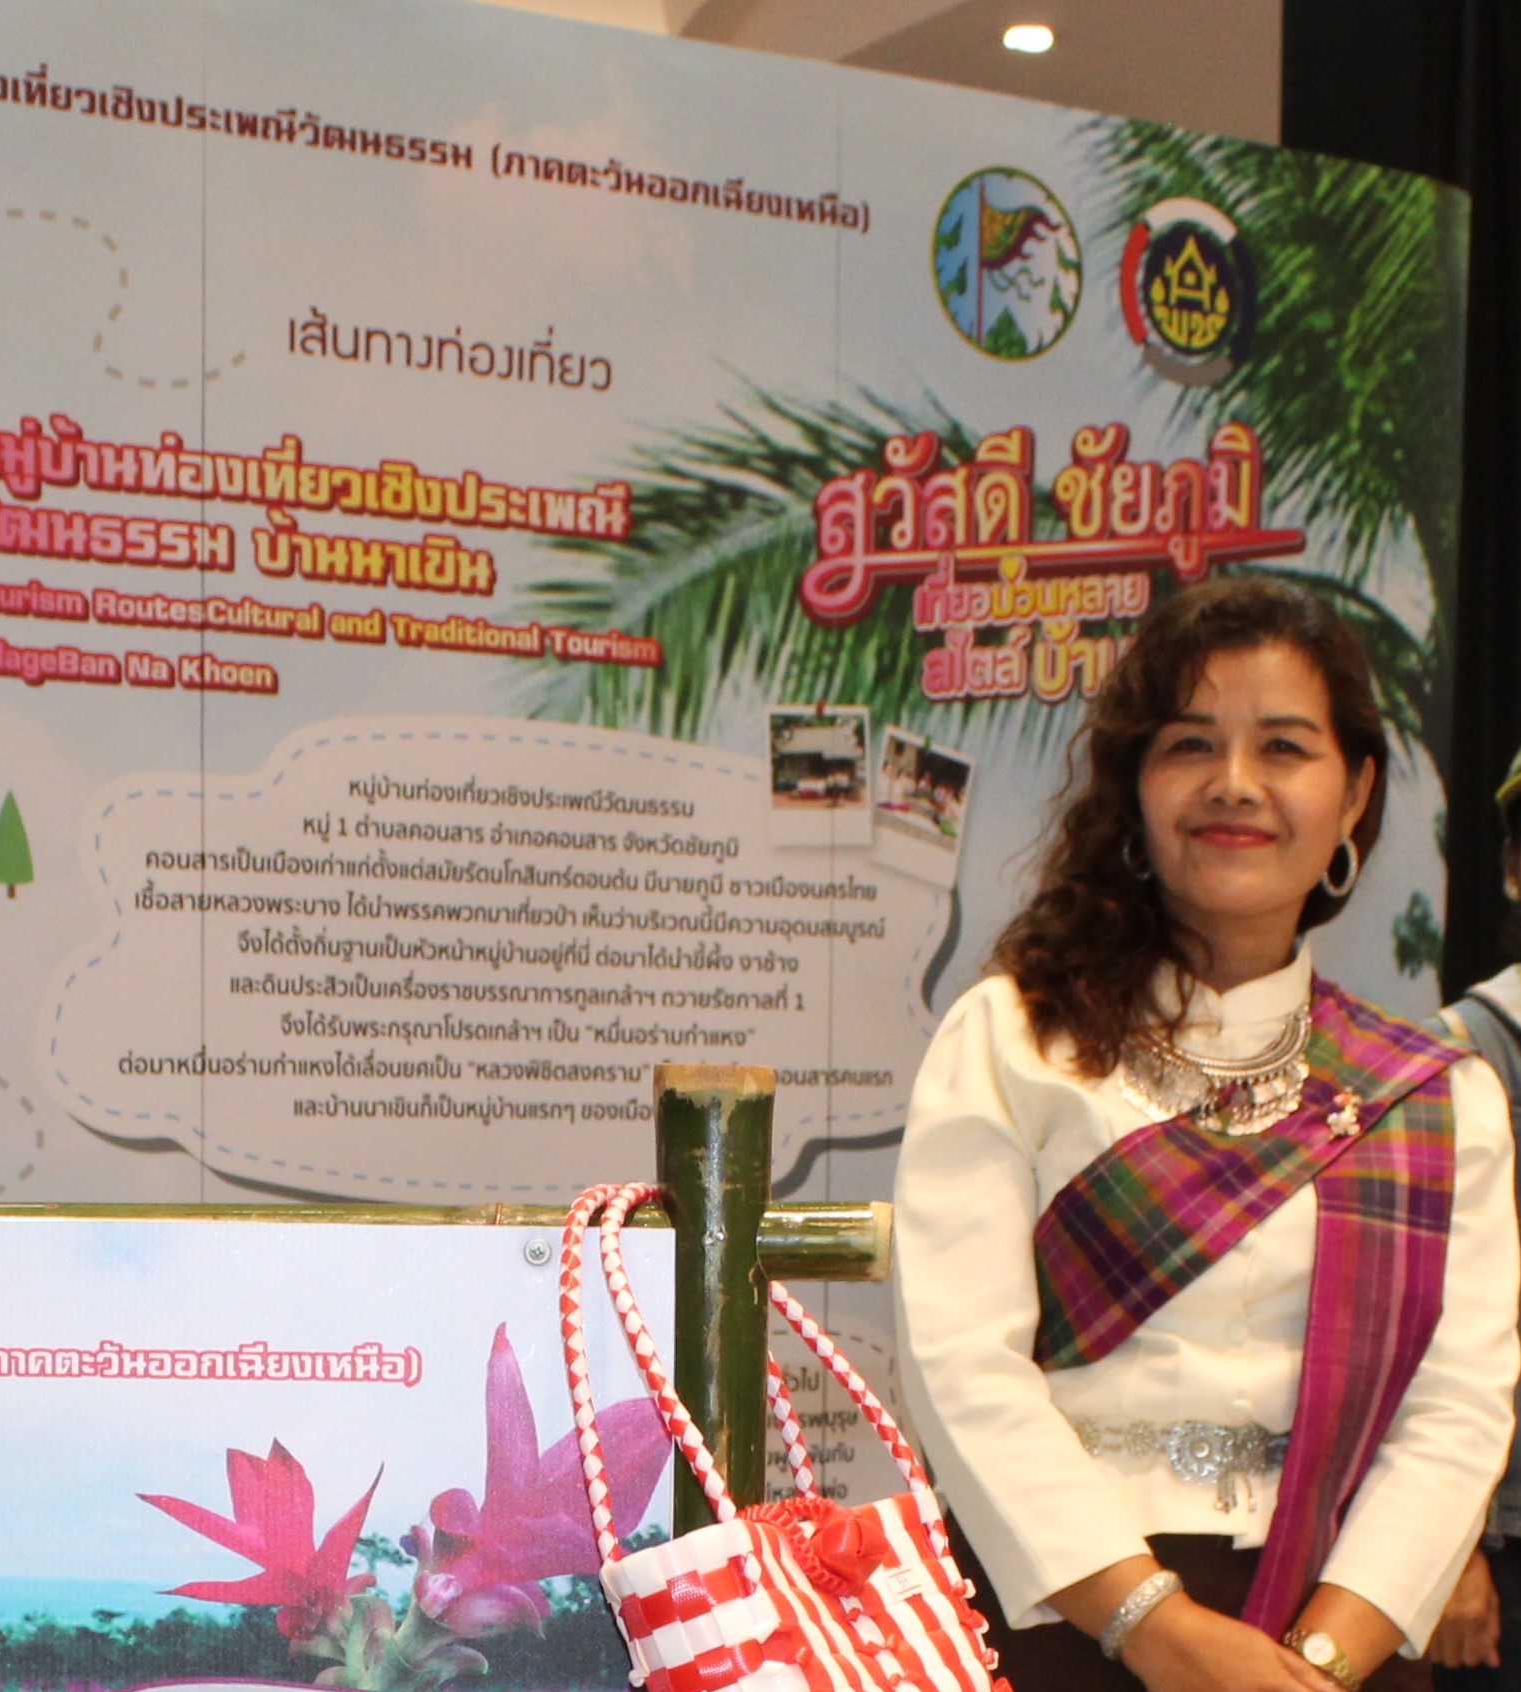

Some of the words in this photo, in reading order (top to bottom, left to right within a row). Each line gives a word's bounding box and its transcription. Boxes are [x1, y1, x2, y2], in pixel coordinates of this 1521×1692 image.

[490, 142, 871, 234] (ภาคตะวันออกเฉียงเหนือ)
[288, 306, 613, 392] เส้นทางท่องเที่ยว
[799, 425, 1037, 627] สวัสดี
[1054, 421, 1266, 583] ชัยภูมิ
[254, 511, 496, 595] บ้านนาเขิน
[328, 610, 381, 642] and
[390, 614, 542, 654] Traditional
[546, 626, 661, 666] Tourism
[124, 653, 172, 687] Na
[177, 656, 277, 692] Khoen
[921, 627, 1029, 706] สไตล์
[349, 773, 695, 818] หมู่บ้านท่องเที่ยวเชิงประเพณีวัฒนธรรม
[303, 813, 331, 843] หมู่
[338, 817, 348, 836] 1
[356, 815, 484, 844] ตำบลคอนสาร
[490, 822, 617, 851] อำเภอคอนสาร
[623, 830, 740, 864] จังหวัดชัยภูมิ
[135, 880, 340, 917] เชื้อสายหลวงพระบาง
[347, 891, 577, 928] ได้นำพรรคพวกมาเที่ยวป่า
[238, 926, 590, 972] จึงได้ตั้งถิ่นฐานเป็นหัวหน้าหมู่บ้านอยู่ที่นี่
[740, 950, 799, 973] งาช้าง
[662, 985, 788, 1011] ถวายรัชกาลที่
[795, 993, 805, 1012] 1
[281, 1010, 542, 1046] จึงได้รับพระกรุณาโปรดเกล้าฯ
[547, 1018, 579, 1043] เป็น
[294, 1093, 576, 1127] และบ้านนาเขินก็เป็นหมู่บ้านแรกๆ
